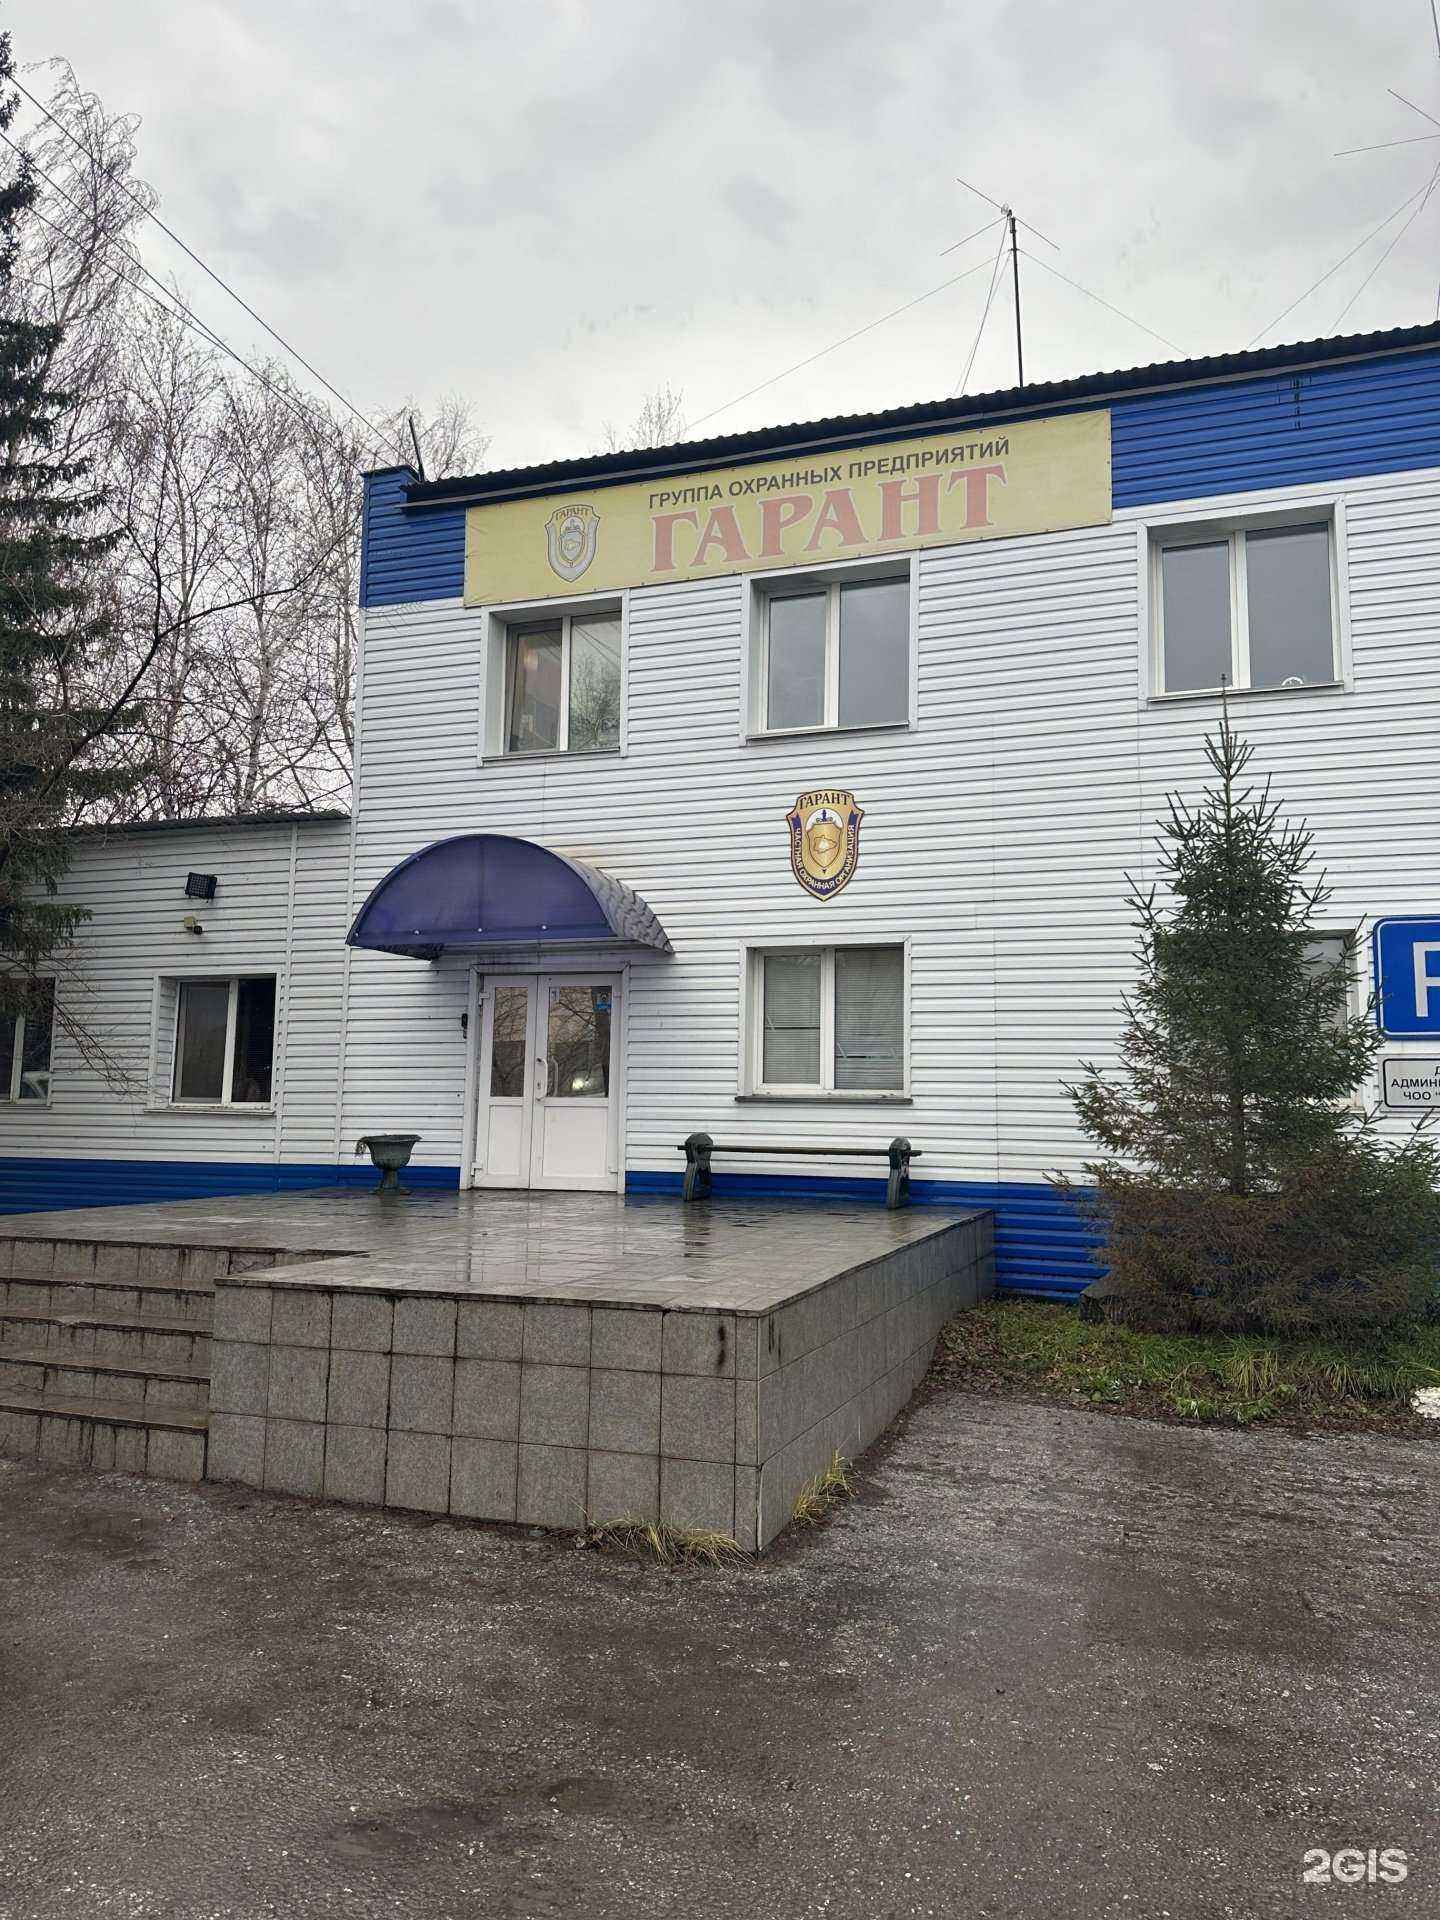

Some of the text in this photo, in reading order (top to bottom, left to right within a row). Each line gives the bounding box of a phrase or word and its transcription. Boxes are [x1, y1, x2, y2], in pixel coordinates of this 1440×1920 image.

[649, 436, 1010, 509] ГРУППА ОХРАННЫХ ПРЕДПРИЯТИЙ
[648, 463, 1008, 574] ГАРАНТ
[799, 792, 850, 809] ГАРАНТ
[1403, 1091, 1432, 1101] ЧОО
